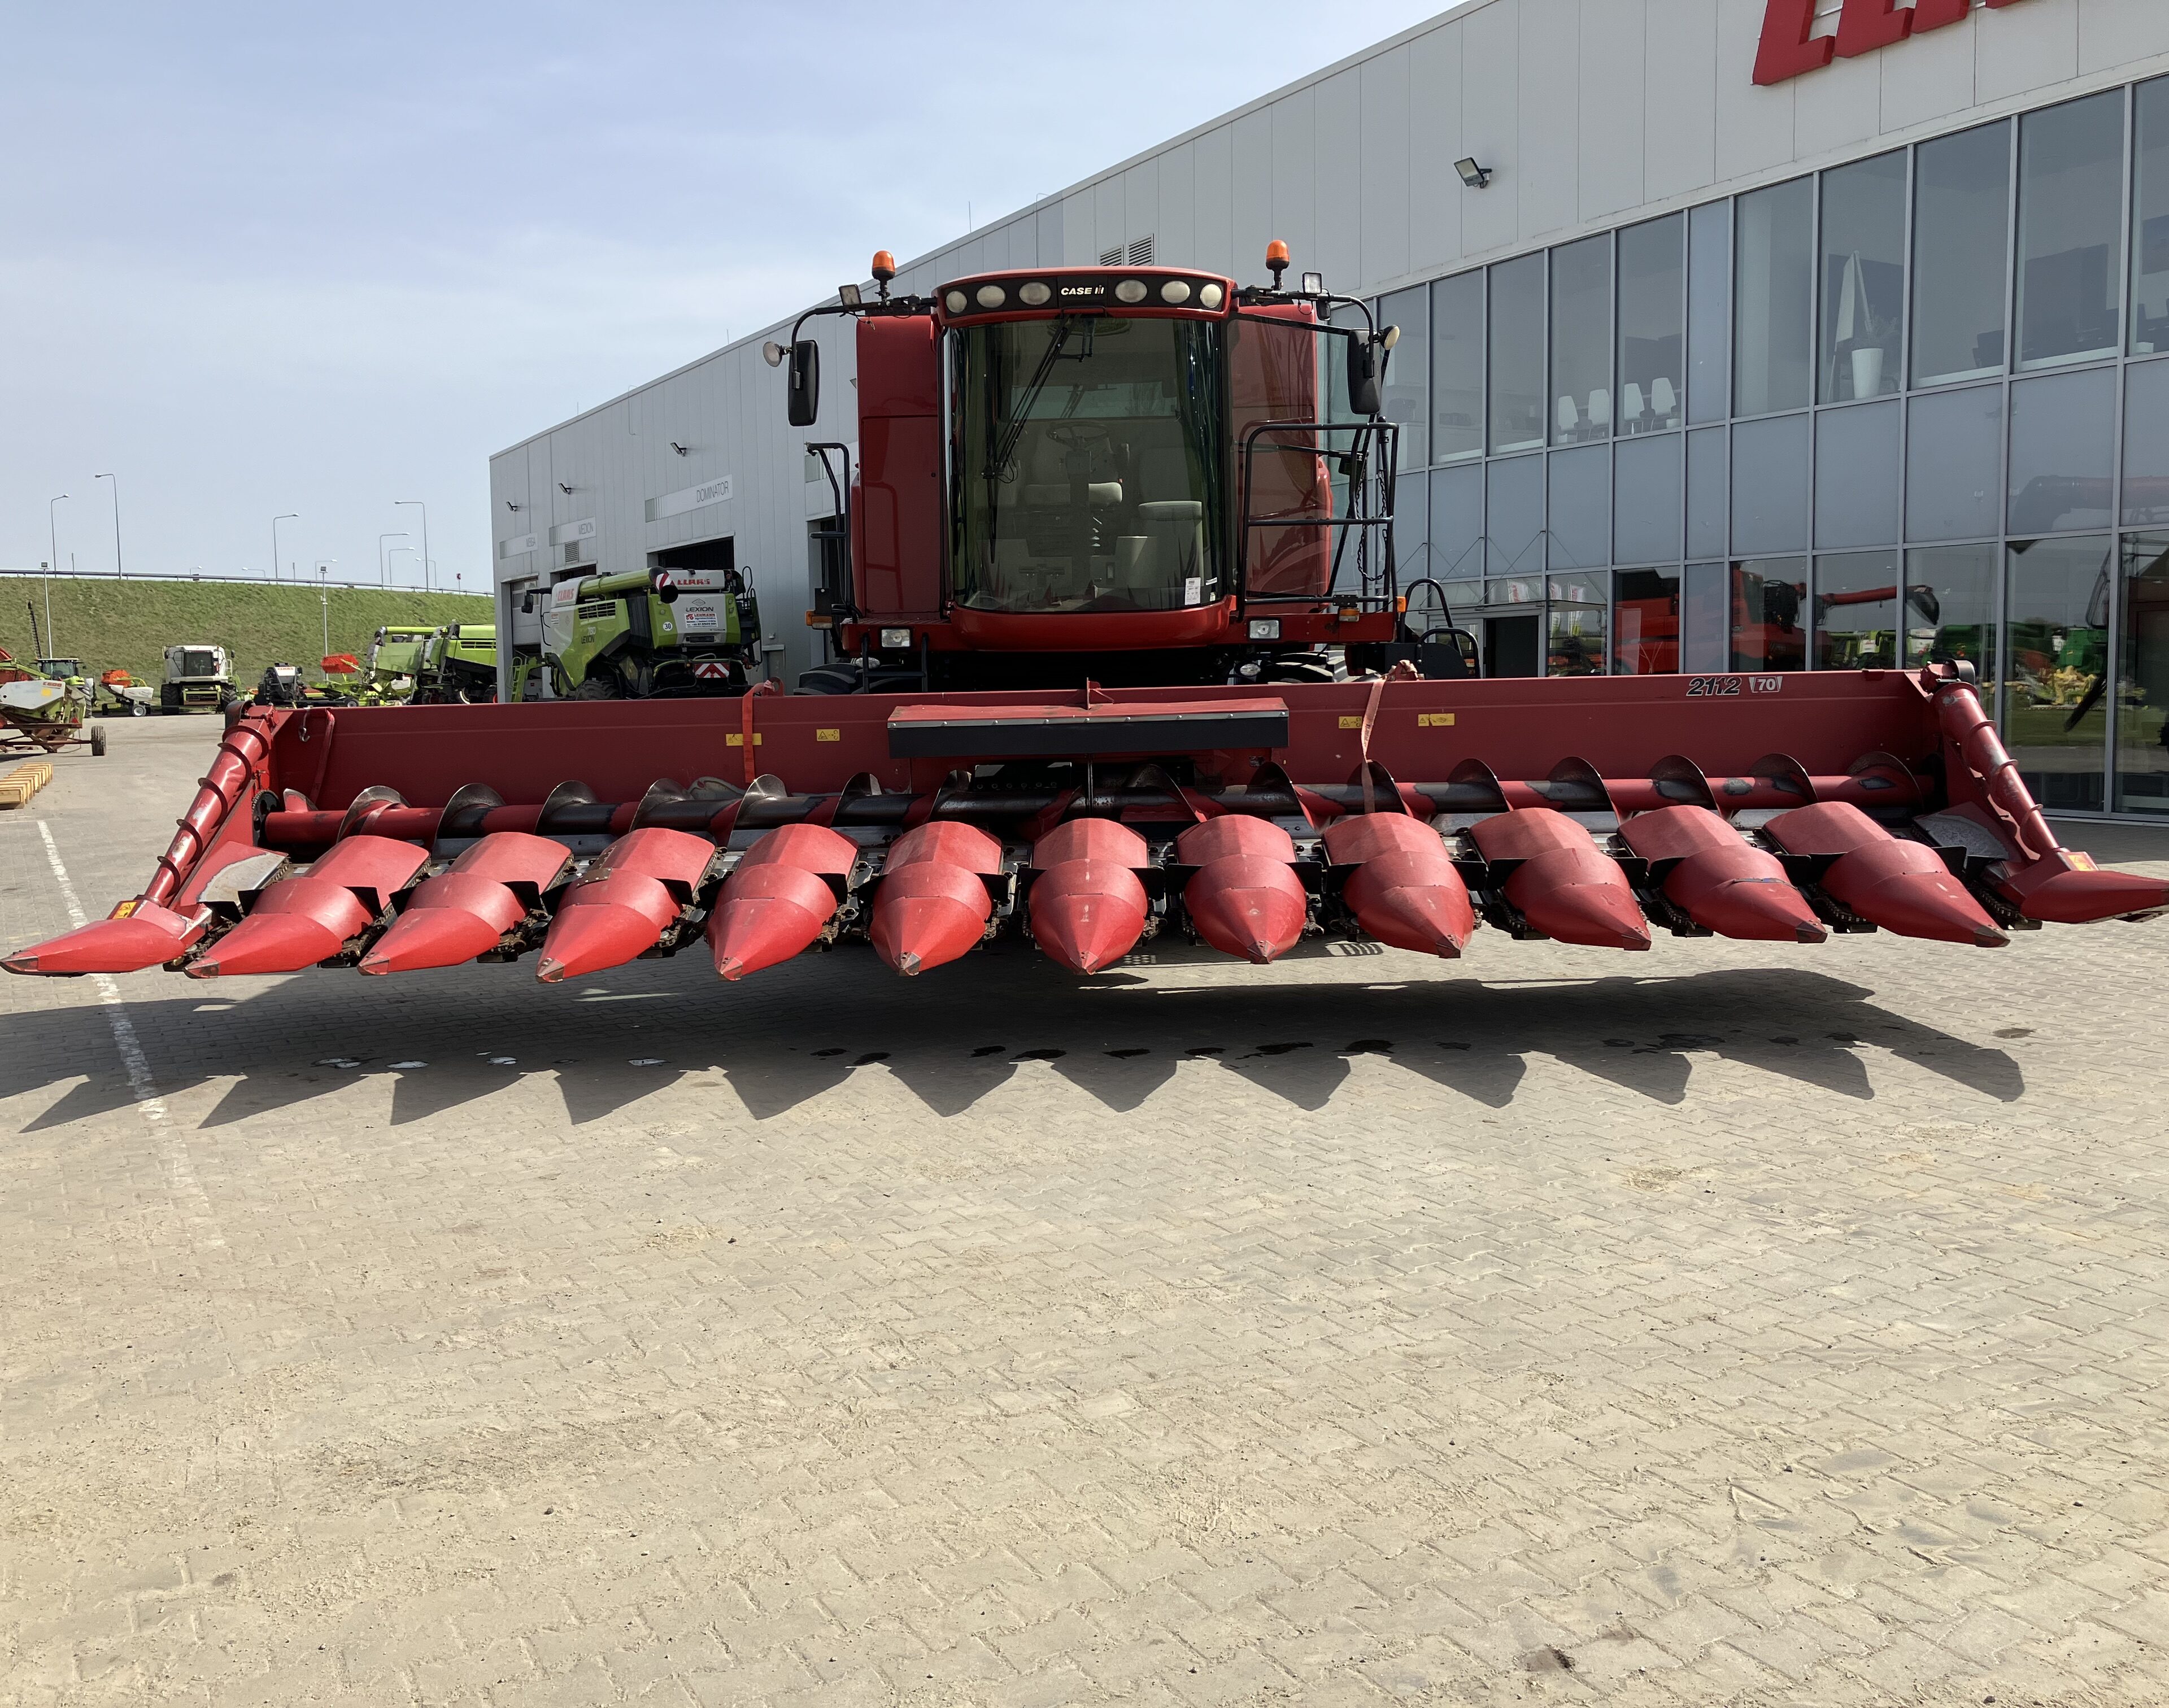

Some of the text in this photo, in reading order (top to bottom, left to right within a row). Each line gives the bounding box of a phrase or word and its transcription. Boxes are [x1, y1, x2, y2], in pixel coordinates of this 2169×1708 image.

[1061, 287, 1092, 295] CASE
[696, 481, 729, 503] DOMINATOR
[557, 588, 575, 602] CLAAS
[1685, 676, 1776, 696] 2112 70
